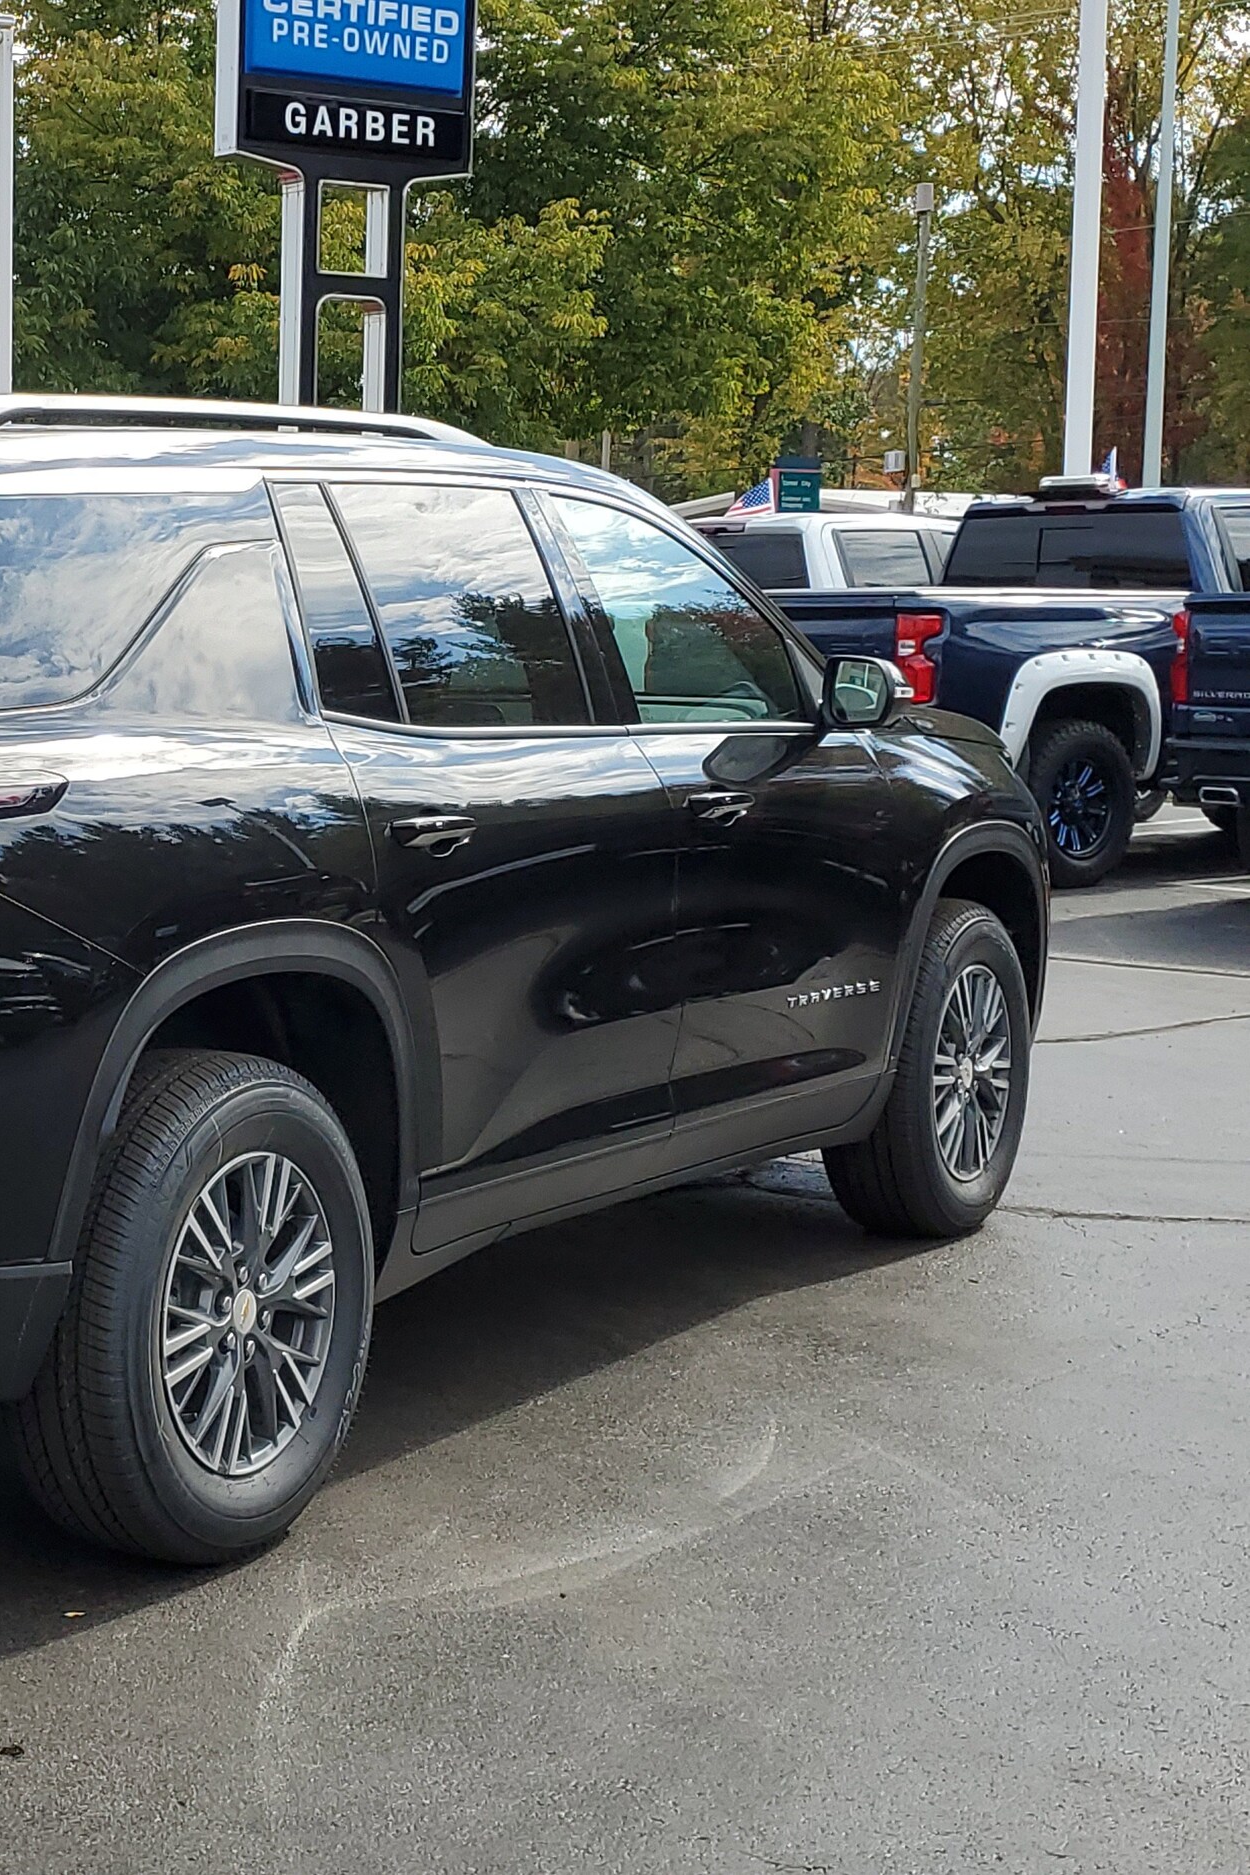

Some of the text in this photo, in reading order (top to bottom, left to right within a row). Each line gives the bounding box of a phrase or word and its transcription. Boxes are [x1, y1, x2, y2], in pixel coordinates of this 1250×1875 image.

[272, 17, 449, 64] PRE-OWNED
[284, 101, 435, 147] GARBER
[787, 980, 881, 1008] TRAVERSE
